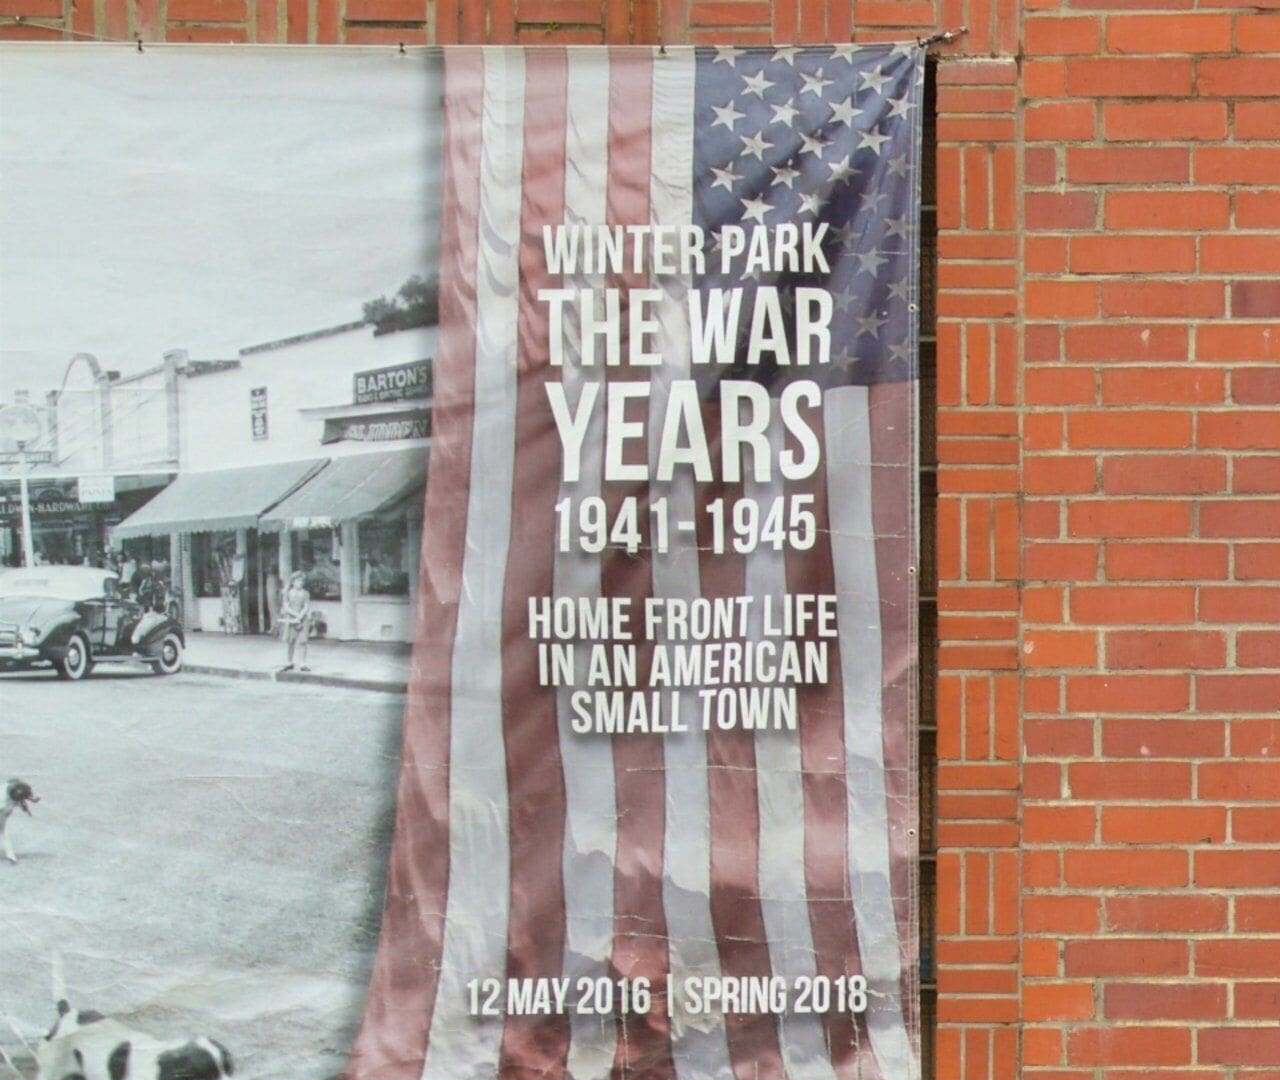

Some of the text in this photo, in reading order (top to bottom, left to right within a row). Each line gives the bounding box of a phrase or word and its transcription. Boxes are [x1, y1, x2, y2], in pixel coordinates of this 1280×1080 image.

[543, 222, 831, 275] WINTER PARK
[537, 287, 834, 367] THE WAR
[544, 379, 823, 482] YEARS
[528, 594, 839, 641] HOME FRONT LIFE
[538, 640, 829, 687] IN AN AMERICAN
[571, 687, 798, 734] SMALL TOWN
[466, 973, 869, 1017] 12 MAY 2016 SPRING 2018
